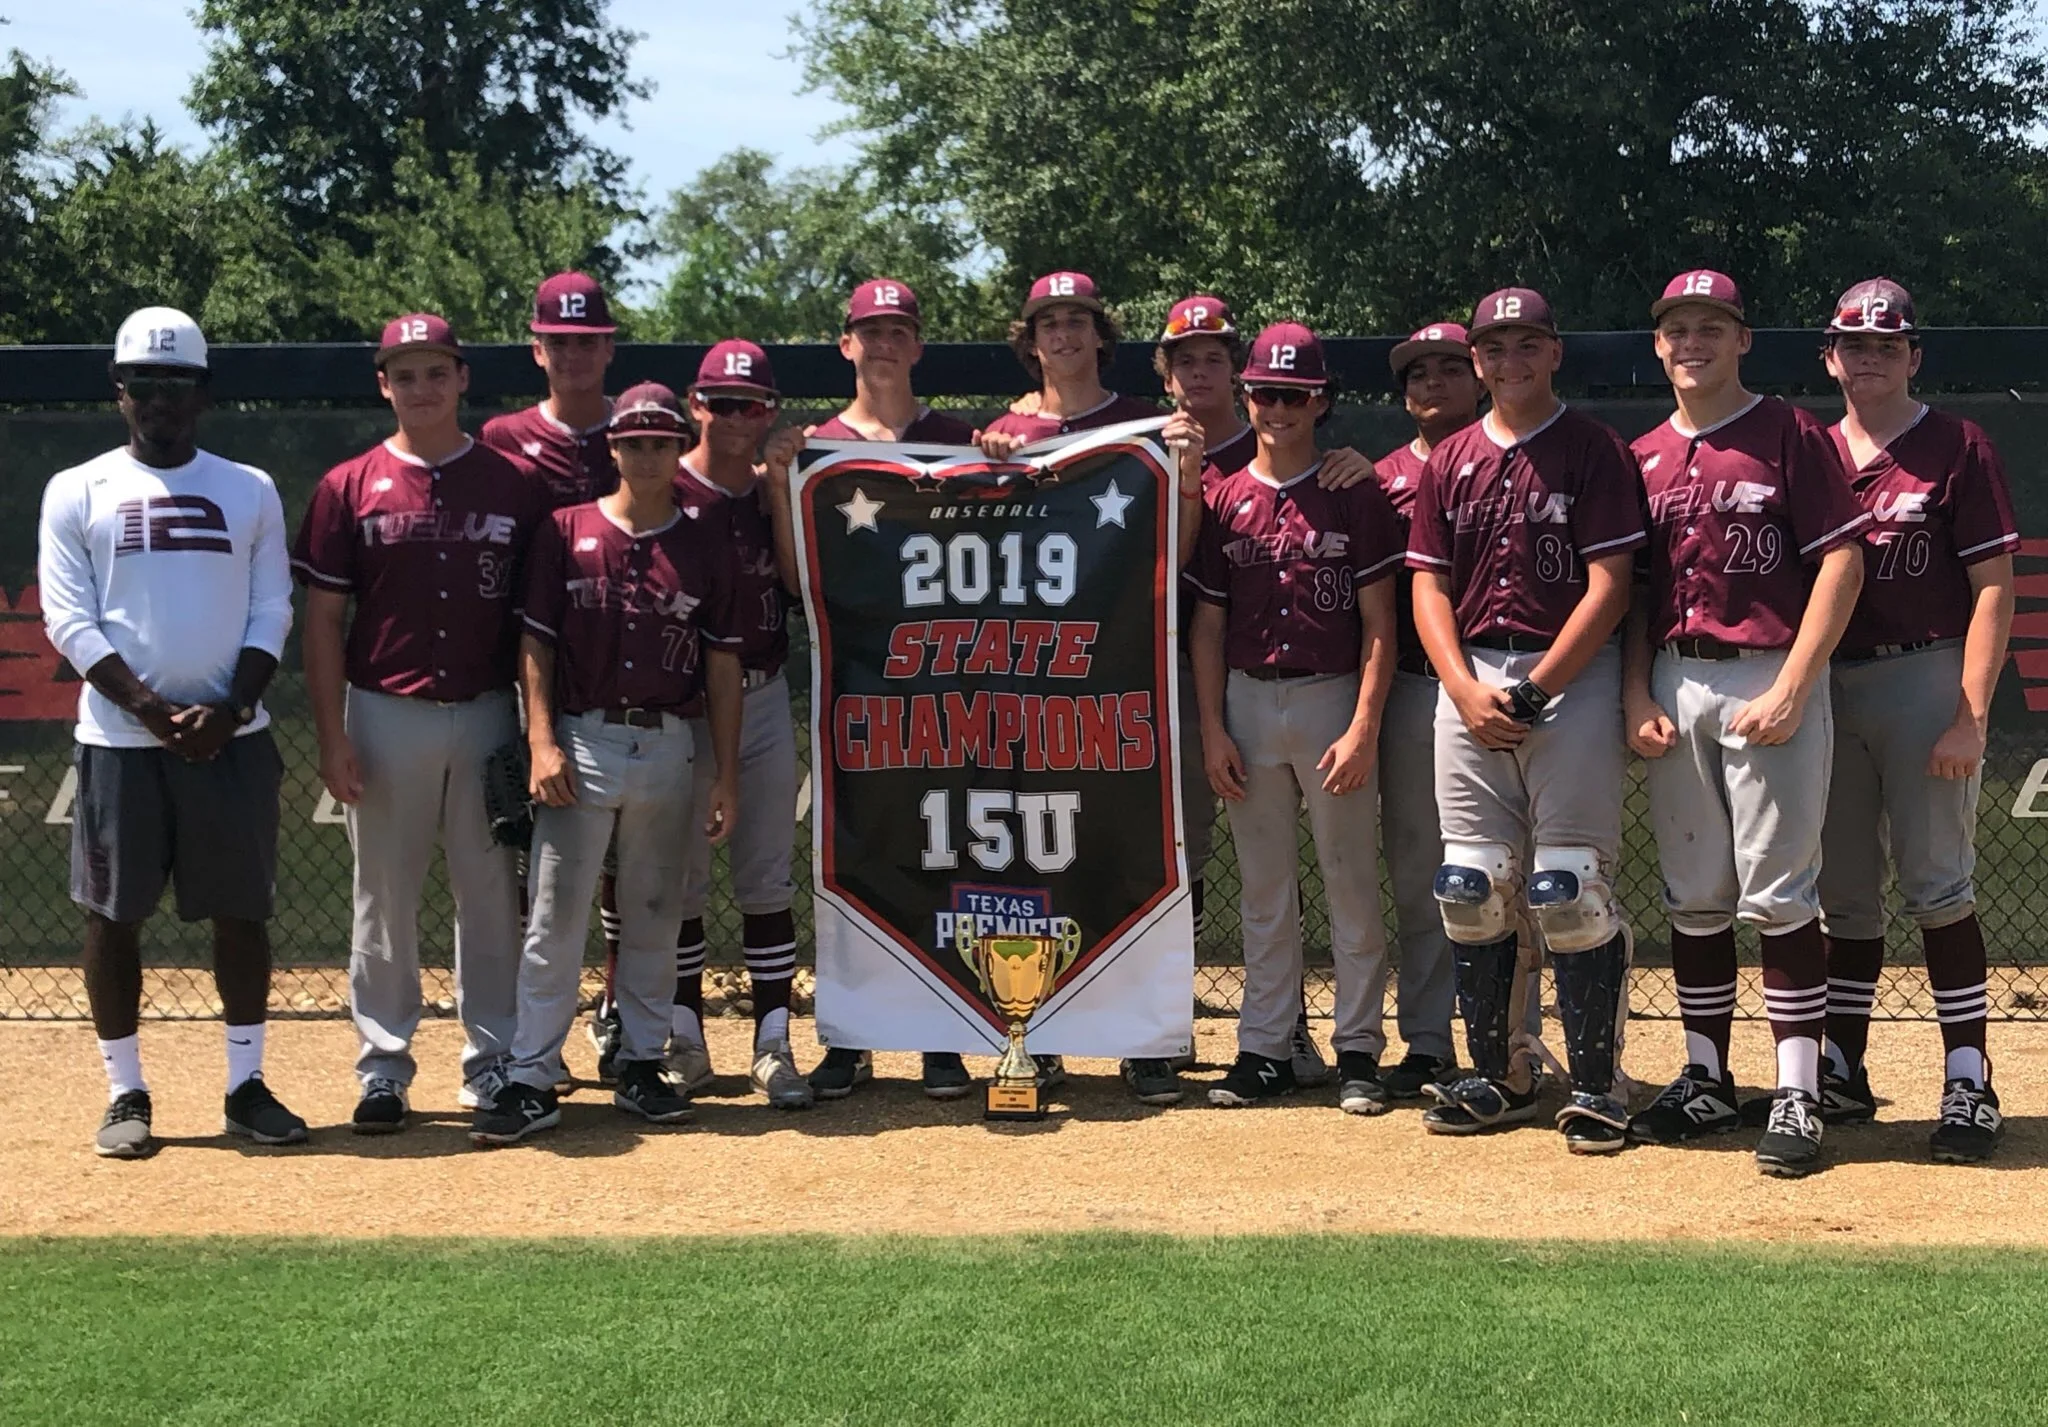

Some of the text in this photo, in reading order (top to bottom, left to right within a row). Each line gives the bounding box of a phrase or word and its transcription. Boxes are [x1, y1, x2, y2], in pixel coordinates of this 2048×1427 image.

[874, 286, 901, 307] 12
[1049, 276, 1076, 297] 12
[1683, 275, 1713, 296] 12
[559, 293, 587, 318] 12
[1493, 297, 1521, 320] 12
[1857, 298, 1889, 322] 12
[147, 328, 176, 351] 12
[400, 319, 430, 343] 12
[723, 352, 752, 377] 12
[1269, 344, 1297, 369] 12
[929, 503, 1049, 519] BASEBALL
[116, 495, 232, 557] 12
[1536, 534, 1581, 583] 81
[1723, 523, 1782, 574] 29
[1876, 530, 1931, 579] 70
[900, 531, 1079, 608] 2019
[1314, 565, 1356, 611] 89
[883, 618, 1100, 679] STATE
[834, 690, 1156, 772] CHAMPIONS
[920, 788, 1081, 874] 15U
[967, 894, 1035, 917] TEXAS
